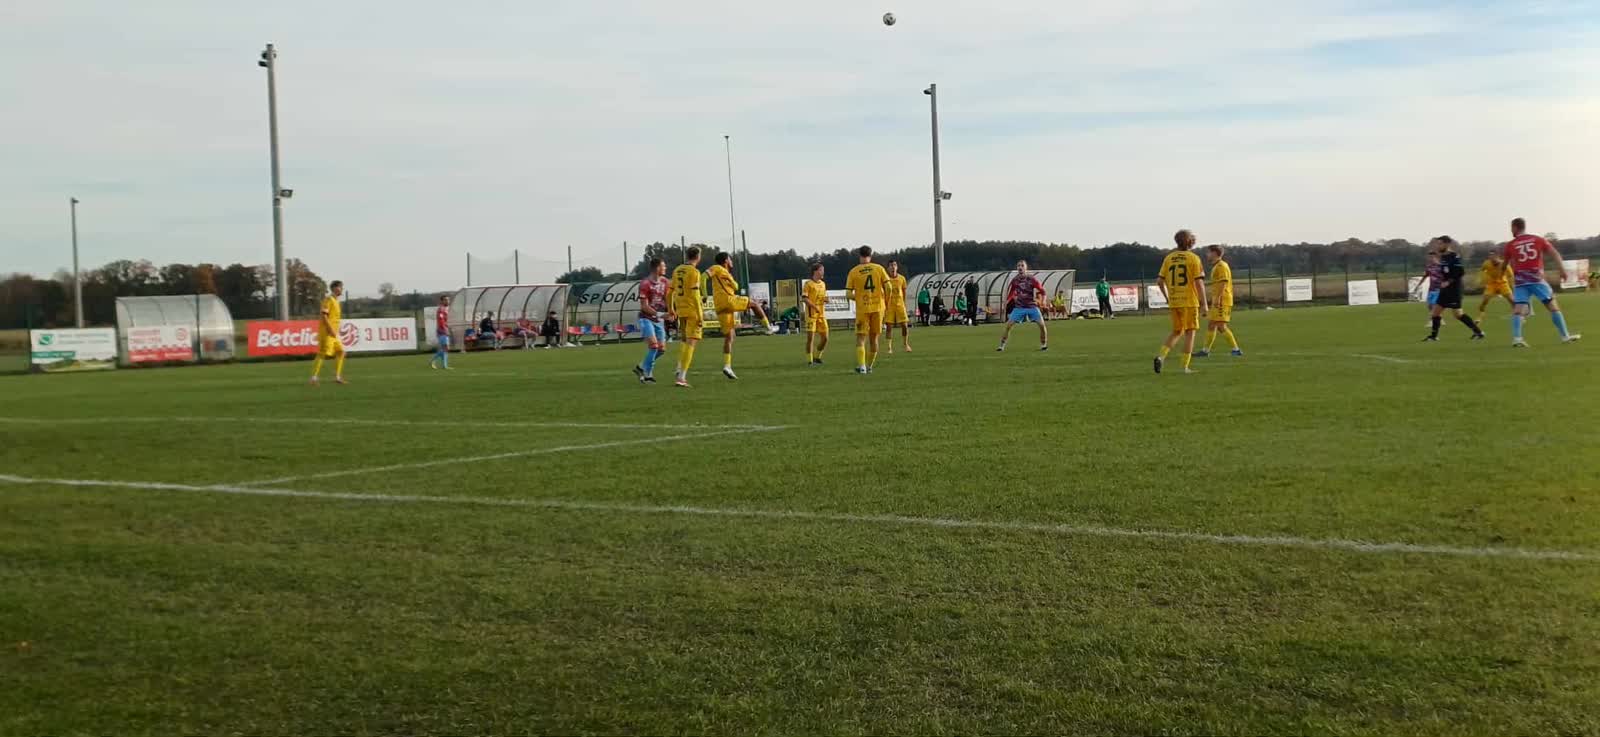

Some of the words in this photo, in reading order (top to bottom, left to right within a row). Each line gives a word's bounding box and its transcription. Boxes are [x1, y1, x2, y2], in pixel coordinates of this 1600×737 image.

[1515, 242, 1538, 262] 35
[864, 274, 876, 292] 4
[1169, 264, 1188, 286] 13
[257, 328, 320, 348] Betclic
[364, 328, 373, 341] 3
[378, 326, 409, 341] LIGA
